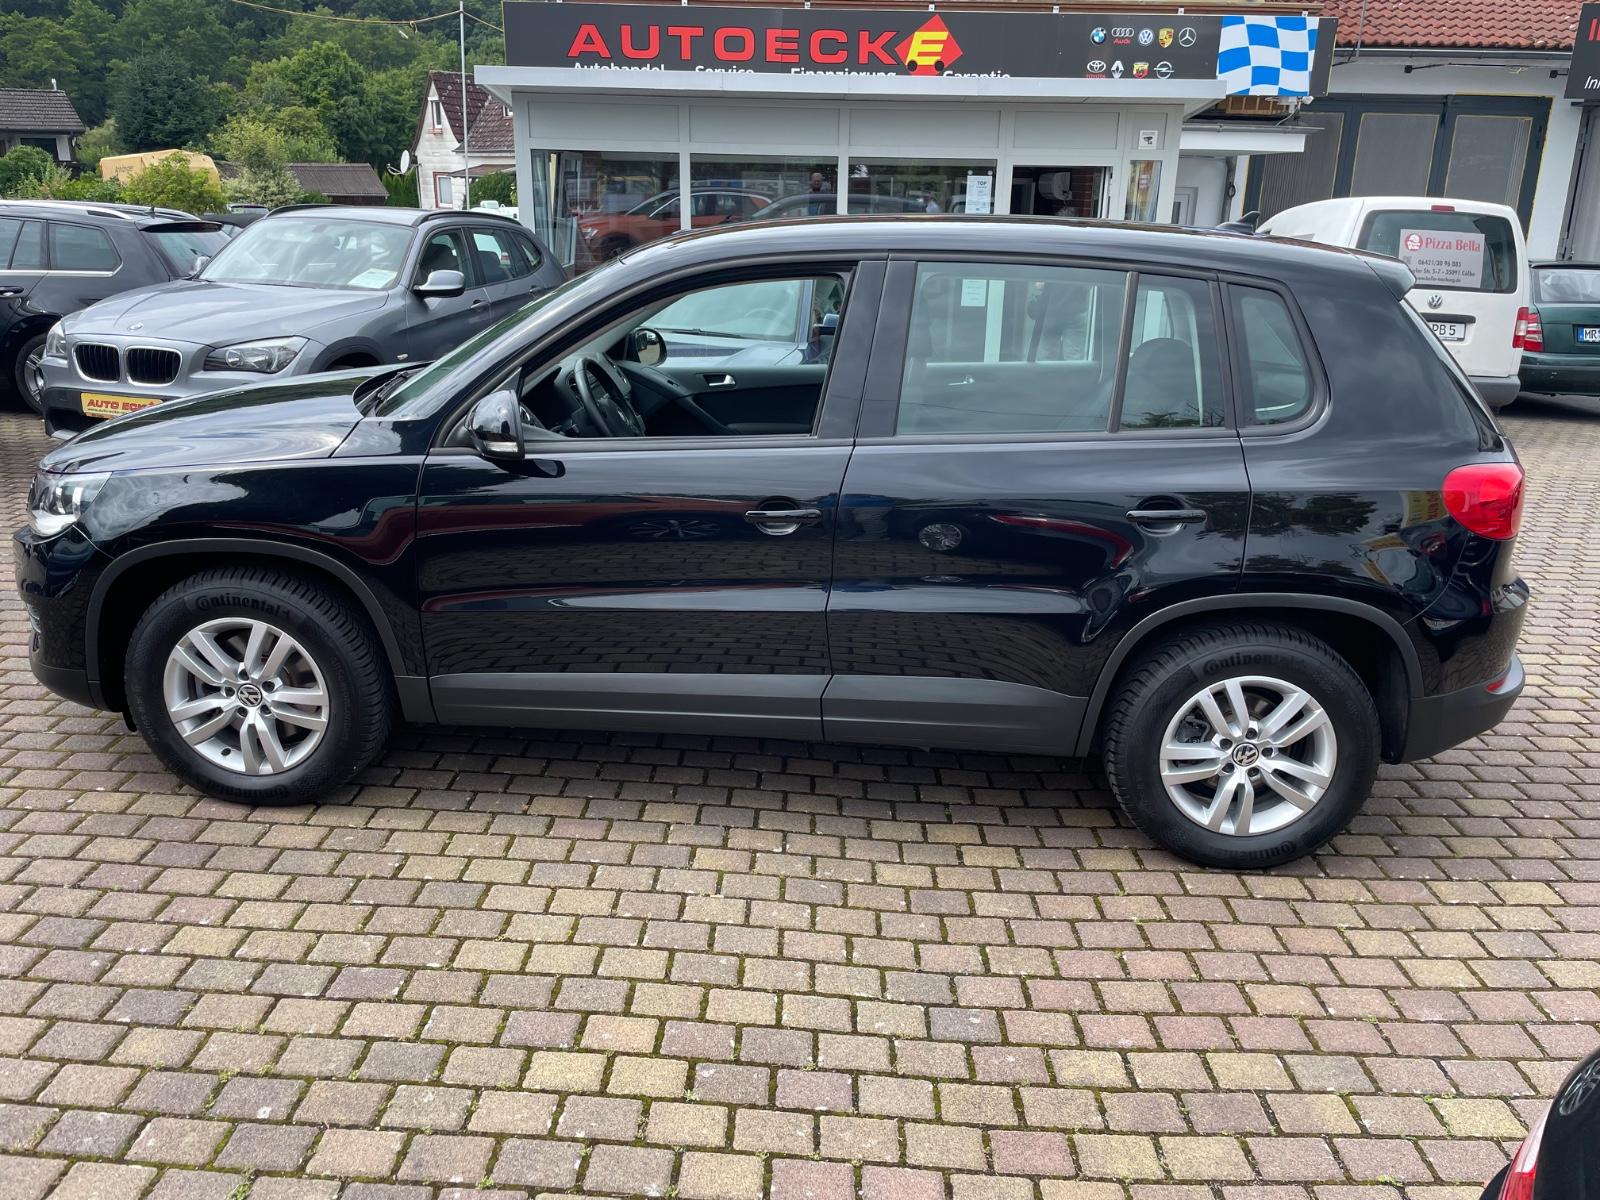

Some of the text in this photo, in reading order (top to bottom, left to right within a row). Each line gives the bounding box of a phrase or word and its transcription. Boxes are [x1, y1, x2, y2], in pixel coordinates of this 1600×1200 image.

[1425, 237, 1481, 252] Pizza Bella
[1448, 324, 1456, 336] 5
[87, 399, 120, 410] AUTO
